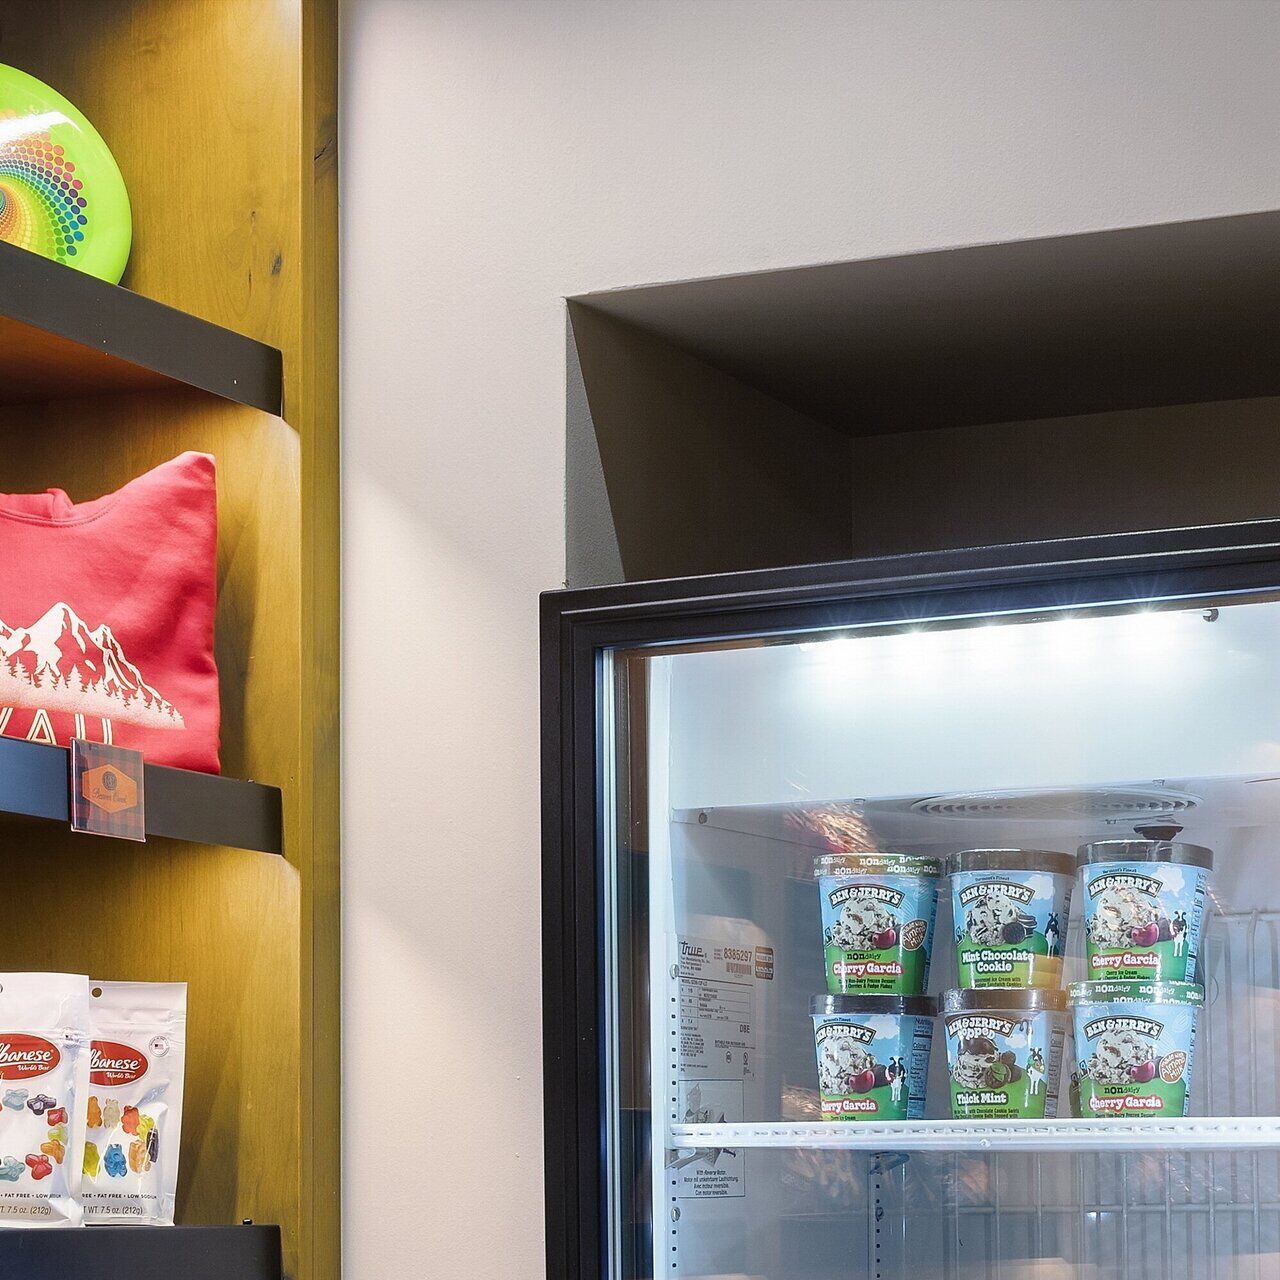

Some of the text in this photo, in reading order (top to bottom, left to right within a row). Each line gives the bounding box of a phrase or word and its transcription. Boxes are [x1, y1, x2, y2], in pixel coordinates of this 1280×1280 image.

[723, 947, 753, 963] 8385297
[962, 950, 1034, 962] Mint Chocolate
[1092, 953, 1159, 967] Cherry Garcia
[868, 961, 902, 975] Garcia
[976, 961, 1012, 973] Cookie
[956, 1093, 1007, 1104] Thick Mint
[1089, 1097, 1161, 1110] Cherry Garcia
[842, 1099, 877, 1111] Garcia
[6, 1206, 18, 1215] 7.5
[29, 1205, 52, 1217] (212g)
[121, 1205, 144, 1216] (212g)
